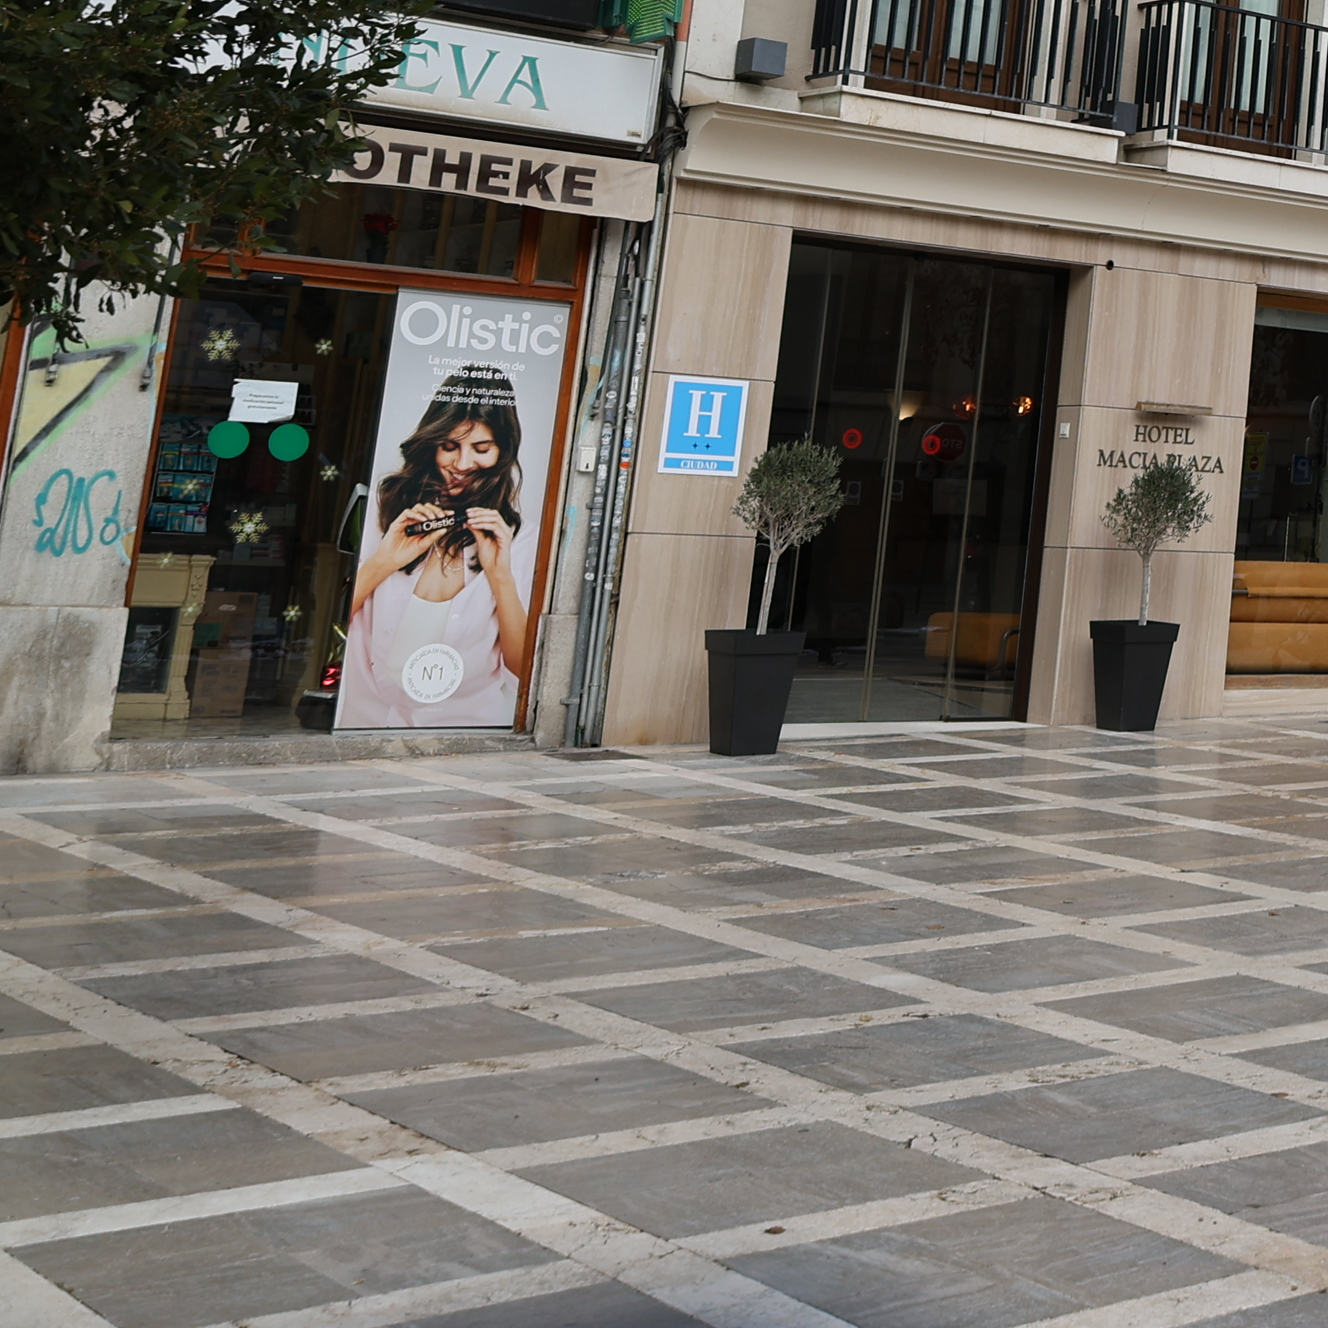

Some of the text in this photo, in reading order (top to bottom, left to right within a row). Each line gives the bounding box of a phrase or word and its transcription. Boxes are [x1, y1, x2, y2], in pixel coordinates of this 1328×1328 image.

[345, 137, 598, 207] OTHEKE
[400, 301, 561, 356] Olistic
[428, 354, 526, 372] La mejor versión de
[433, 366, 444, 376] tu
[444, 365, 469, 379] pelo
[470, 369, 493, 380] está
[494, 372, 507, 381] en
[451, 392, 479, 404] desde
[480, 395, 488, 405] el
[465, 386, 471, 395] y
[683, 389, 728, 439] H
[1133, 424, 1196, 445] HOTEL
[680, 459, 718, 471] CIUDAD
[1096, 449, 1161, 470] MACIA
[422, 516, 456, 532] Olistic
